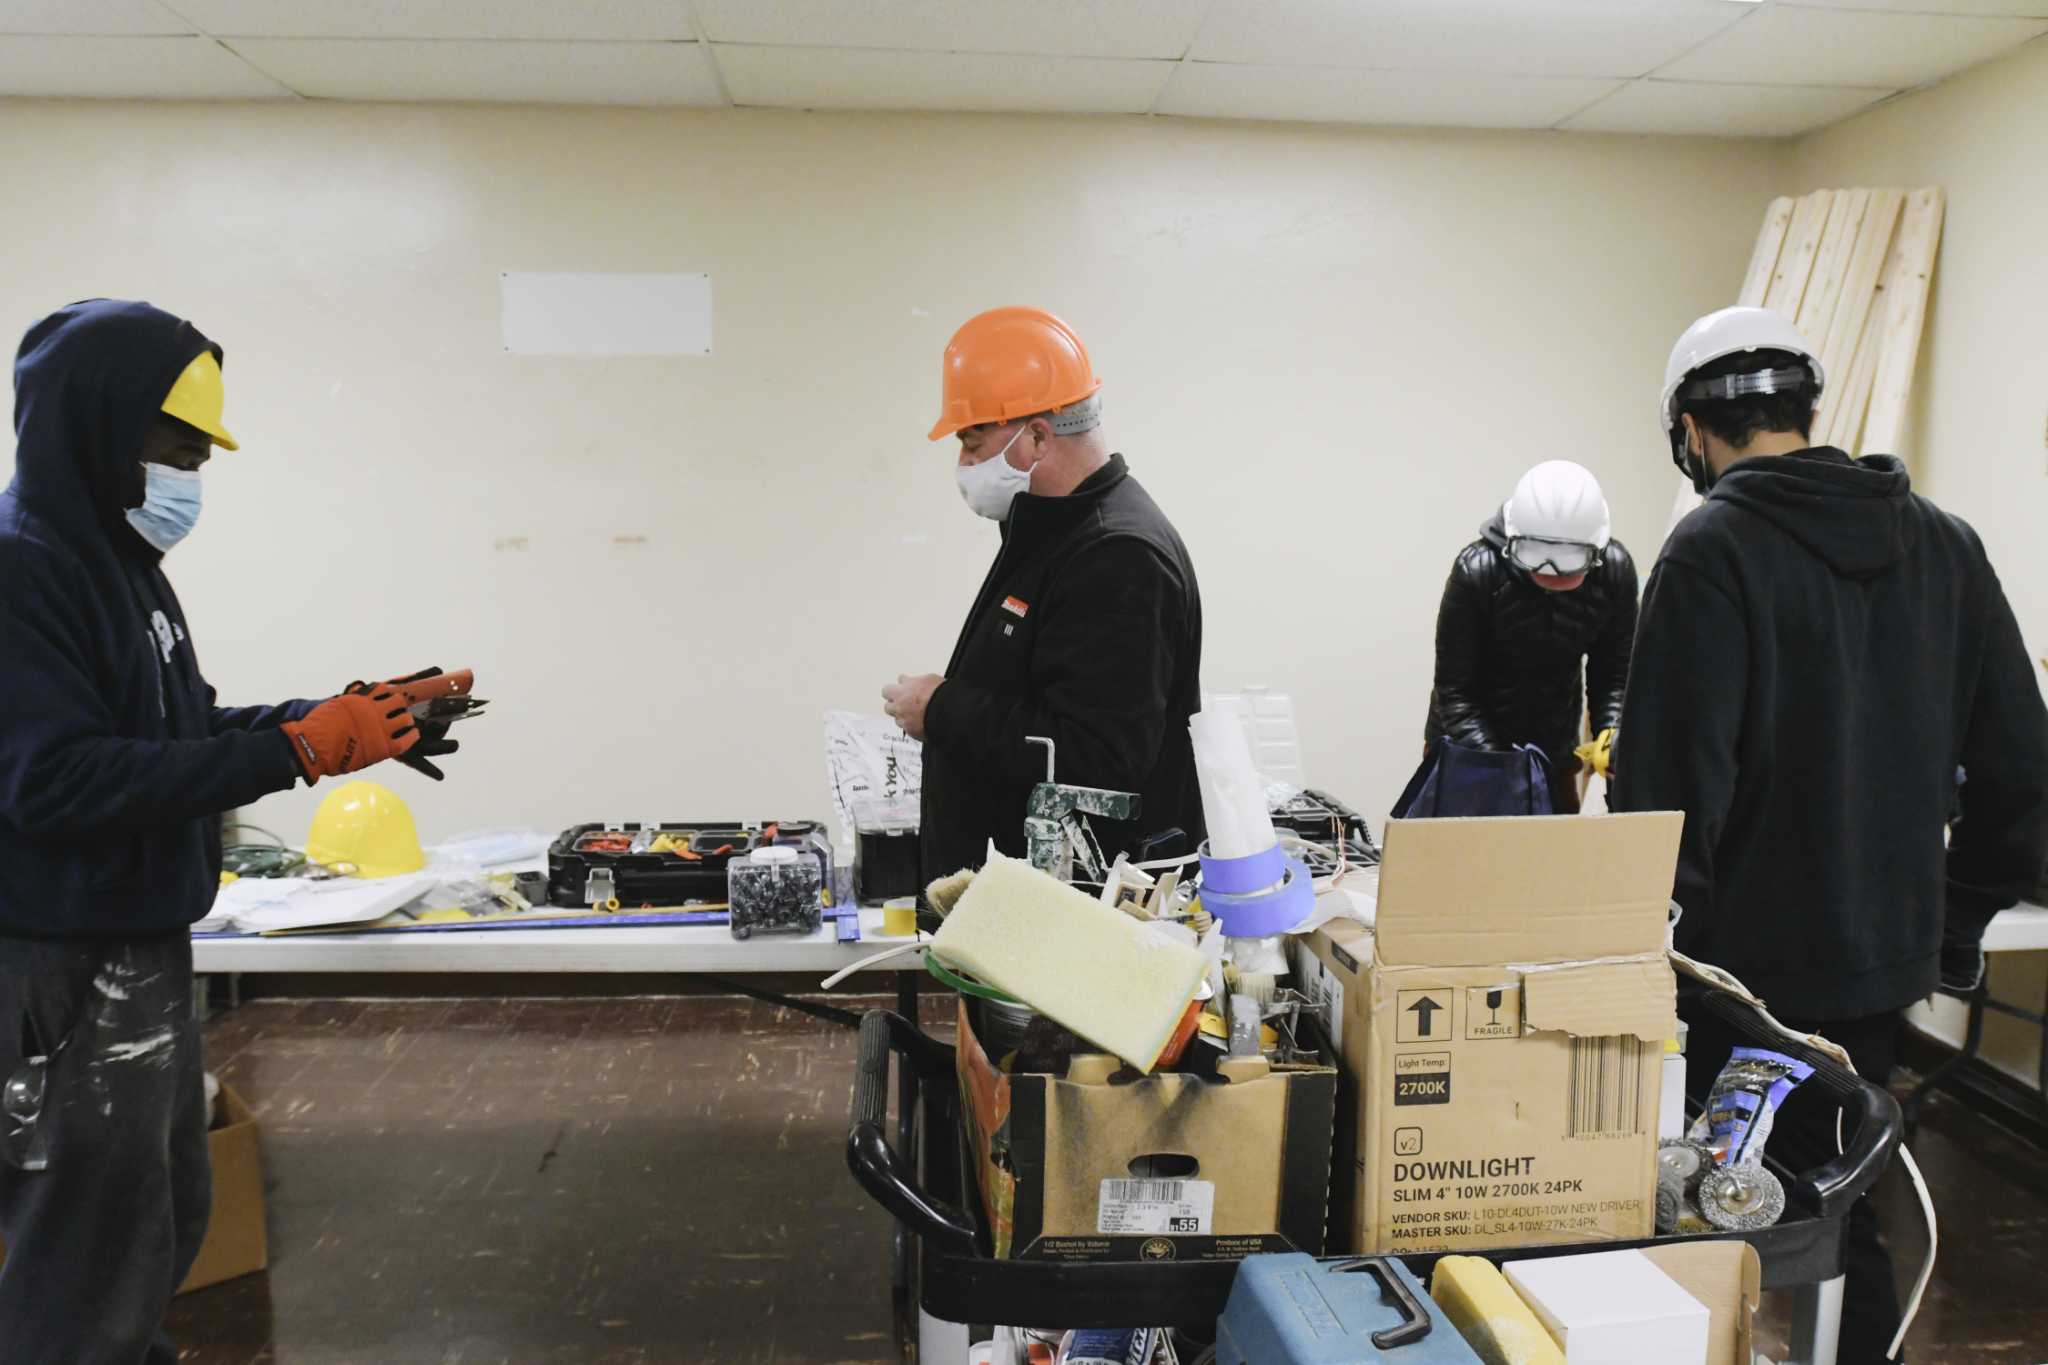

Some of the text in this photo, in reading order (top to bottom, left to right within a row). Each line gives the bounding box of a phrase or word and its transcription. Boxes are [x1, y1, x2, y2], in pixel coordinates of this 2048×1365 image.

[1474, 1026, 1513, 1035] FRAGILE
[1398, 1058, 1420, 1069] Light
[1399, 1081, 1446, 1096] 2700K
[1400, 1136, 1417, 1151] v2
[1393, 1156, 1536, 1182] DOWNLIGHT
[1393, 1188, 1431, 1202] SLIM
[1456, 1185, 1488, 1199] 10W
[1493, 1182, 1540, 1197] 2700K
[1544, 1179, 1583, 1194] 24PK
[1392, 1212, 1440, 1224] VENDOR
[1443, 1210, 1471, 1222] SKU:
[1571, 1203, 1598, 1214] NEW
[1600, 1199, 1641, 1212] DRIVER
[1391, 1226, 1441, 1239] MASTER
[1444, 1225, 1472, 1236] SKU:
